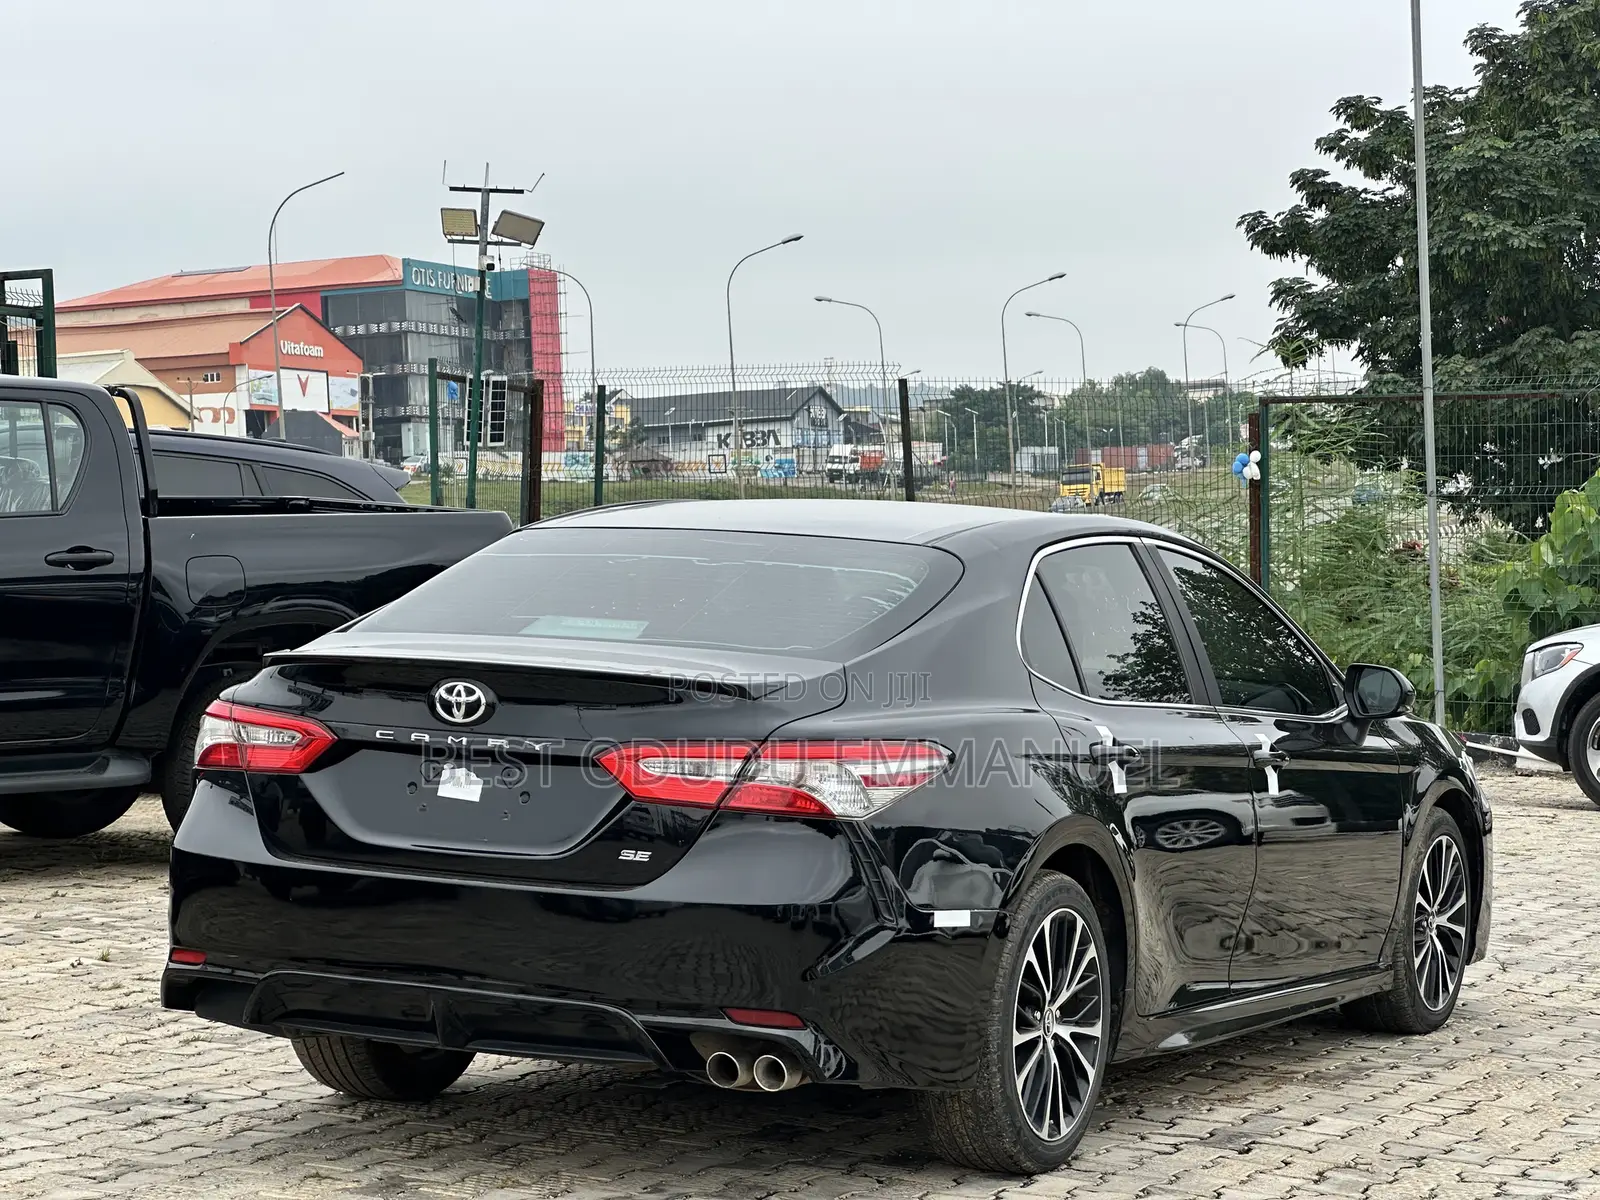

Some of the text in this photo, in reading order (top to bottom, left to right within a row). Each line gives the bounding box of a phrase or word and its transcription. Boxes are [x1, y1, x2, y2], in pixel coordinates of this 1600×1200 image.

[412, 267, 436, 288] OTIS
[280, 339, 324, 358] Vitafoam
[716, 429, 782, 449] KBBA
[375, 729, 552, 750] CAMRY
[617, 849, 653, 862] SE
